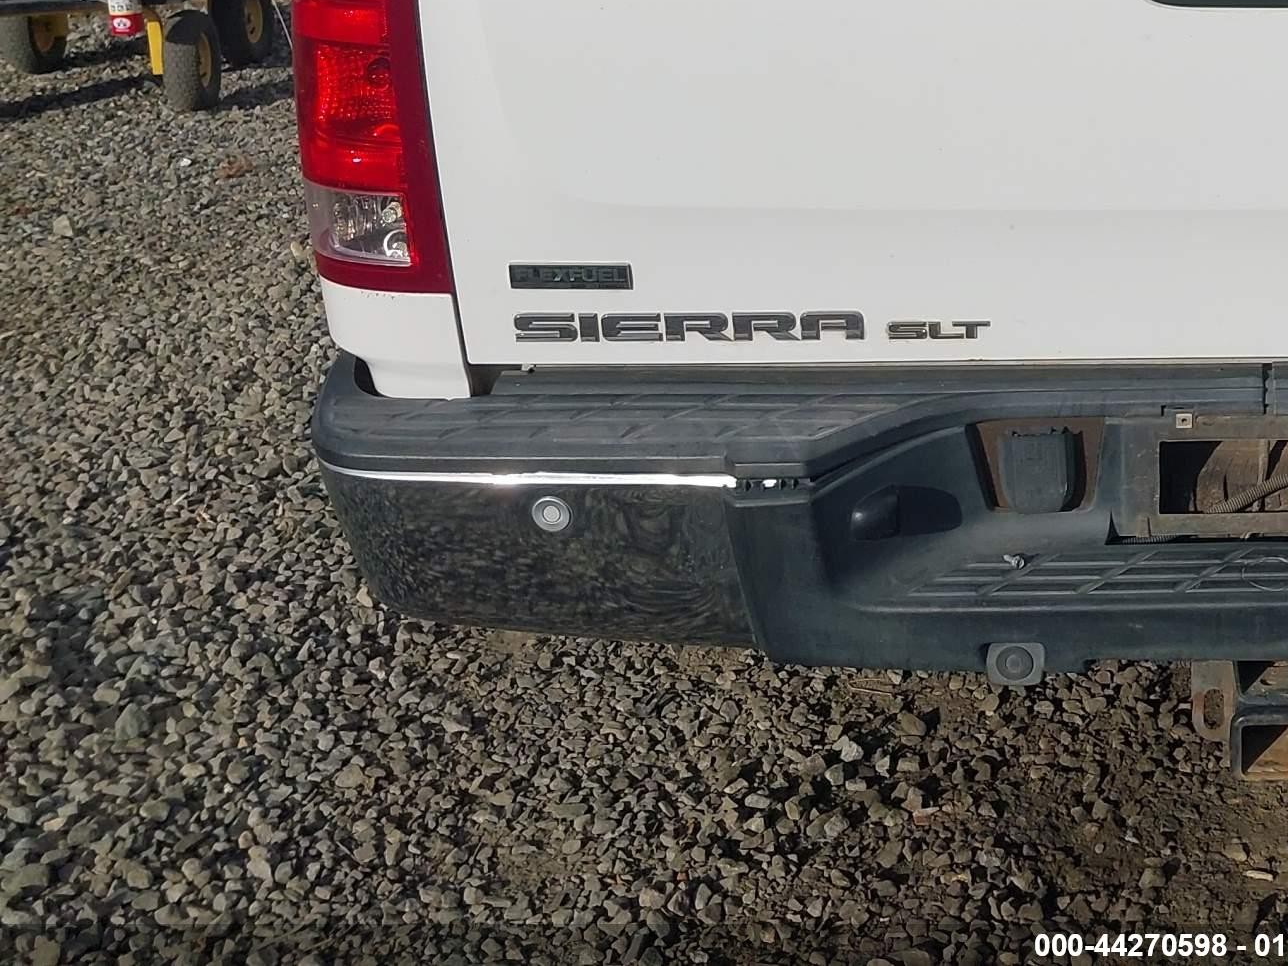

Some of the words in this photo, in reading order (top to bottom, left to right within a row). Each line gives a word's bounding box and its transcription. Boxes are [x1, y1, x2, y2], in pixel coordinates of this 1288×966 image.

[513, 266, 626, 283] FLEXFUEL
[513, 312, 864, 343] SIERRA
[887, 321, 991, 340] SLT
